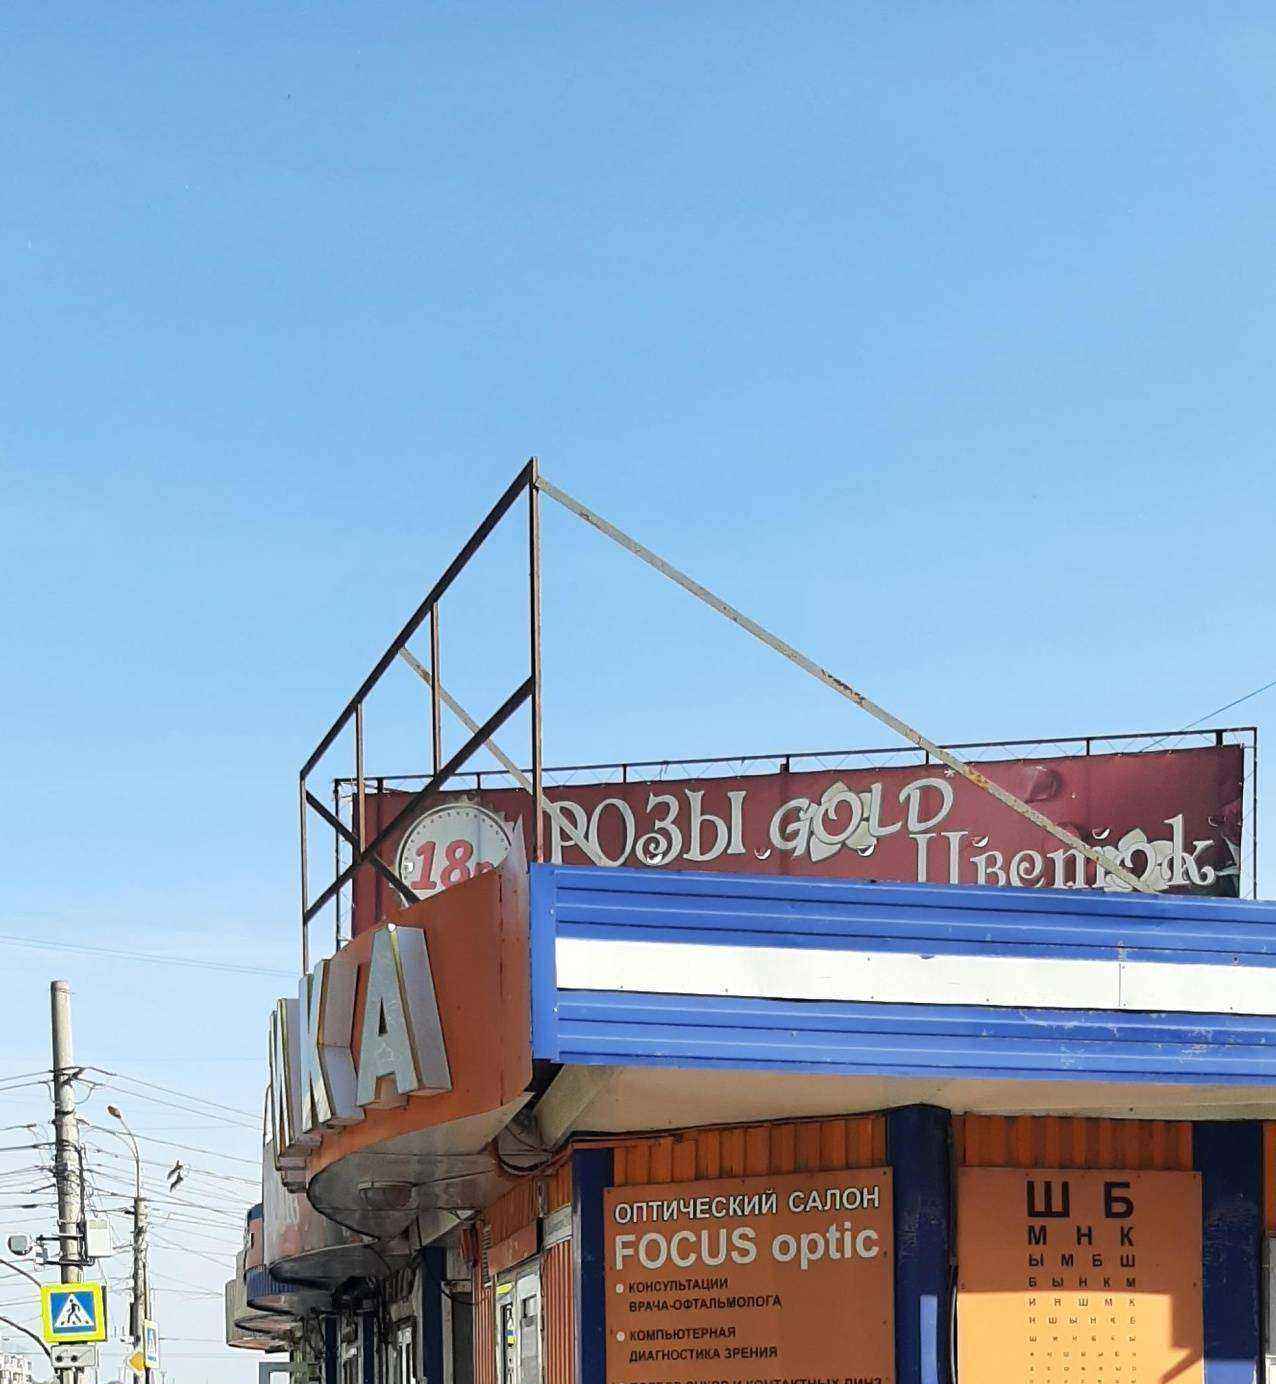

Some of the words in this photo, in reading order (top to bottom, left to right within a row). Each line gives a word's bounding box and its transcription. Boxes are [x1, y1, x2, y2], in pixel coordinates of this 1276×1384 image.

[549, 790, 744, 867] РОЗЫ
[769, 777, 954, 858] GOLD
[613, 1190, 777, 1224] ОПТИЧЕСКИЙ
[788, 1185, 880, 1214] САЛОН
[1026, 1181, 1070, 1218] Ш
[1104, 1181, 1135, 1219] Б
[1027, 1225, 1047, 1246] М
[1076, 1226, 1093, 1246] Н
[1120, 1226, 1134, 1247] К
[614, 1226, 757, 1270] FOCUS
[771, 1221, 880, 1271] optic
[1028, 1254, 1044, 1267] Ы
[1061, 1254, 1074, 1267] М
[1092, 1254, 1103, 1267] Б
[1120, 1254, 1136, 1268] Ш
[628, 1278, 729, 1294] КОНСУЛЬТАЦИИ
[1028, 1277, 1037, 1288] Б
[1052, 1277, 1064, 1288] Ы
[1078, 1277, 1088, 1288] Н
[1103, 1277, 1111, 1288] К
[1125, 1277, 1136, 1288] М
[629, 1295, 783, 1312] ВРАЧА-ОФТАЛЬМОЛОГА
[629, 1327, 737, 1342] КОМПЬЮТЕРНАЯ
[629, 1349, 721, 1364] ДИАГНОСТИКА
[724, 1346, 778, 1360] ЗРЕНИЯ
